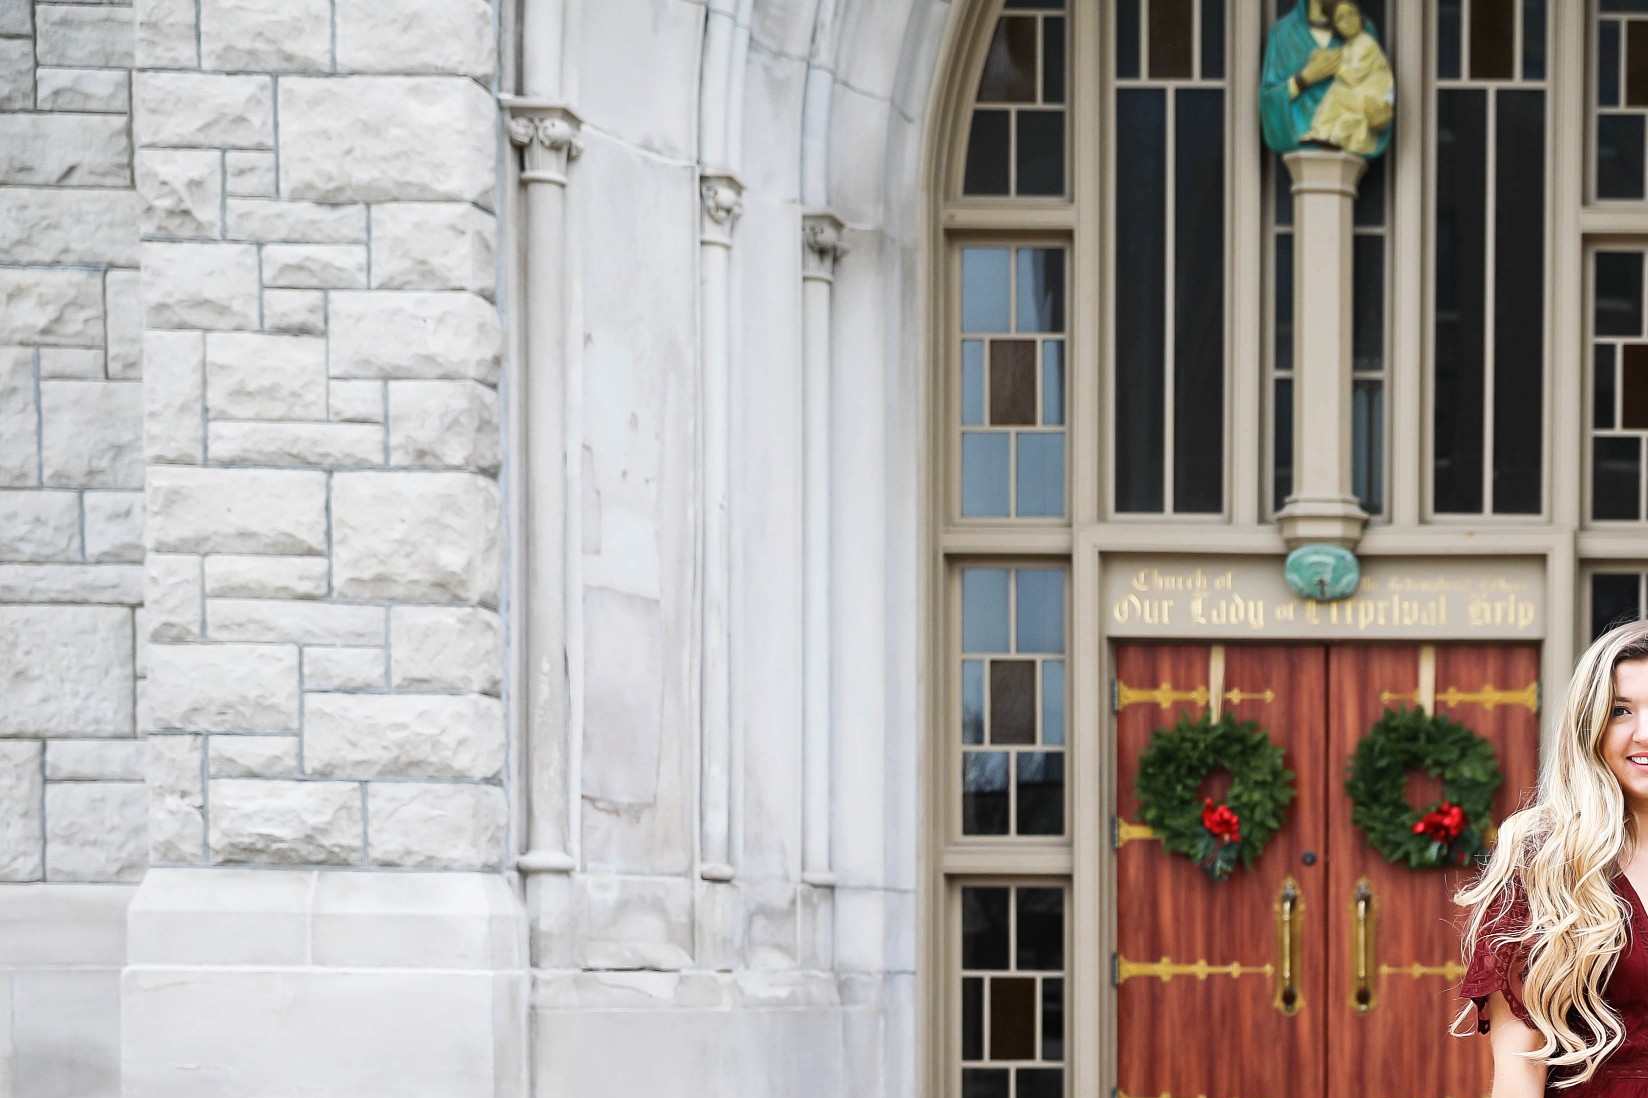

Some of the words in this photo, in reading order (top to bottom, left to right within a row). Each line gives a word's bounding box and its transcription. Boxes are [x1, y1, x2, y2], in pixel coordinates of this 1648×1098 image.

[1131, 568, 1207, 591] Church
[1214, 569, 1236, 591] of
[1113, 593, 1174, 625] Our
[1190, 591, 1265, 630] Lady
[1468, 592, 1536, 630] Help
